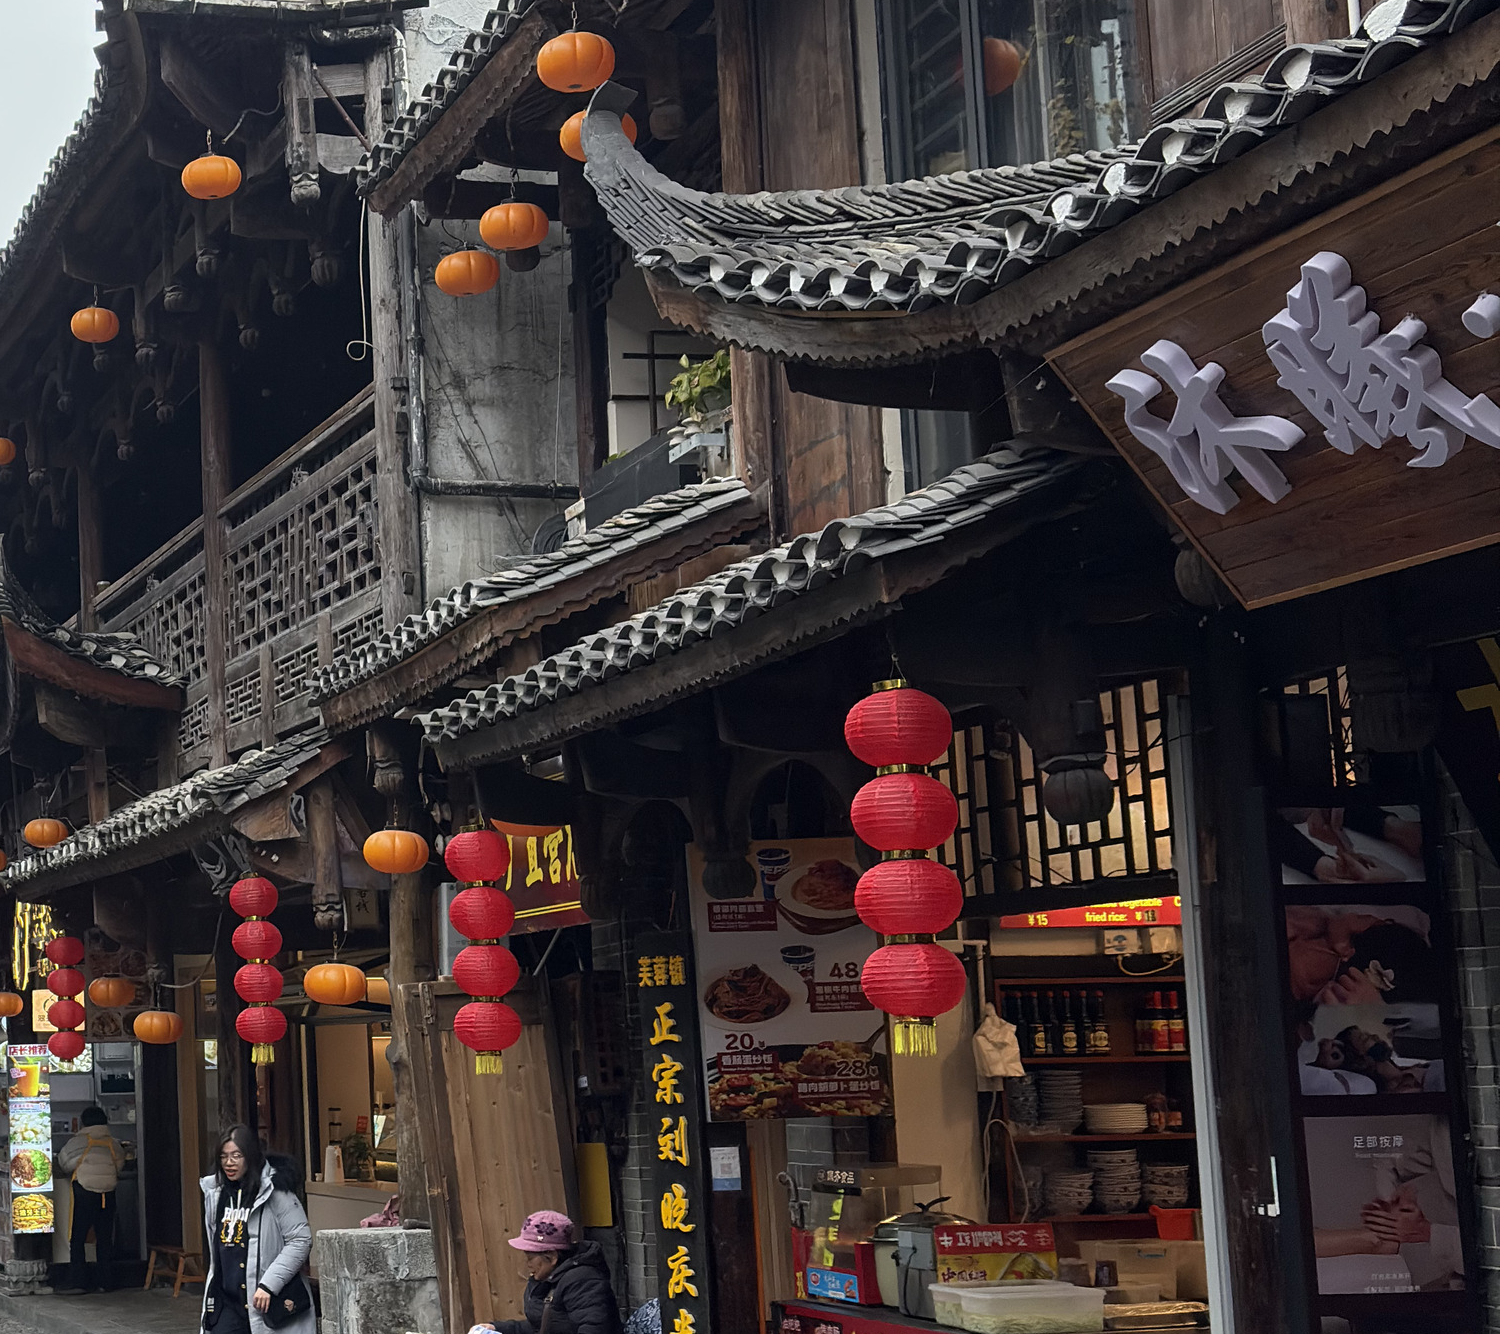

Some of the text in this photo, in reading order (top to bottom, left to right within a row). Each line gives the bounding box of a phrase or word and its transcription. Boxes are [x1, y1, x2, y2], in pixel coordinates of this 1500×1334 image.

[1085, 912, 1107, 922] fried
[828, 962, 859, 979] 48
[724, 1033, 754, 1051] 20
[8, 1045, 48, 1056] 店长推荐
[836, 1061, 866, 1077] 28
[1353, 1135, 1404, 1149] 足部按摩
